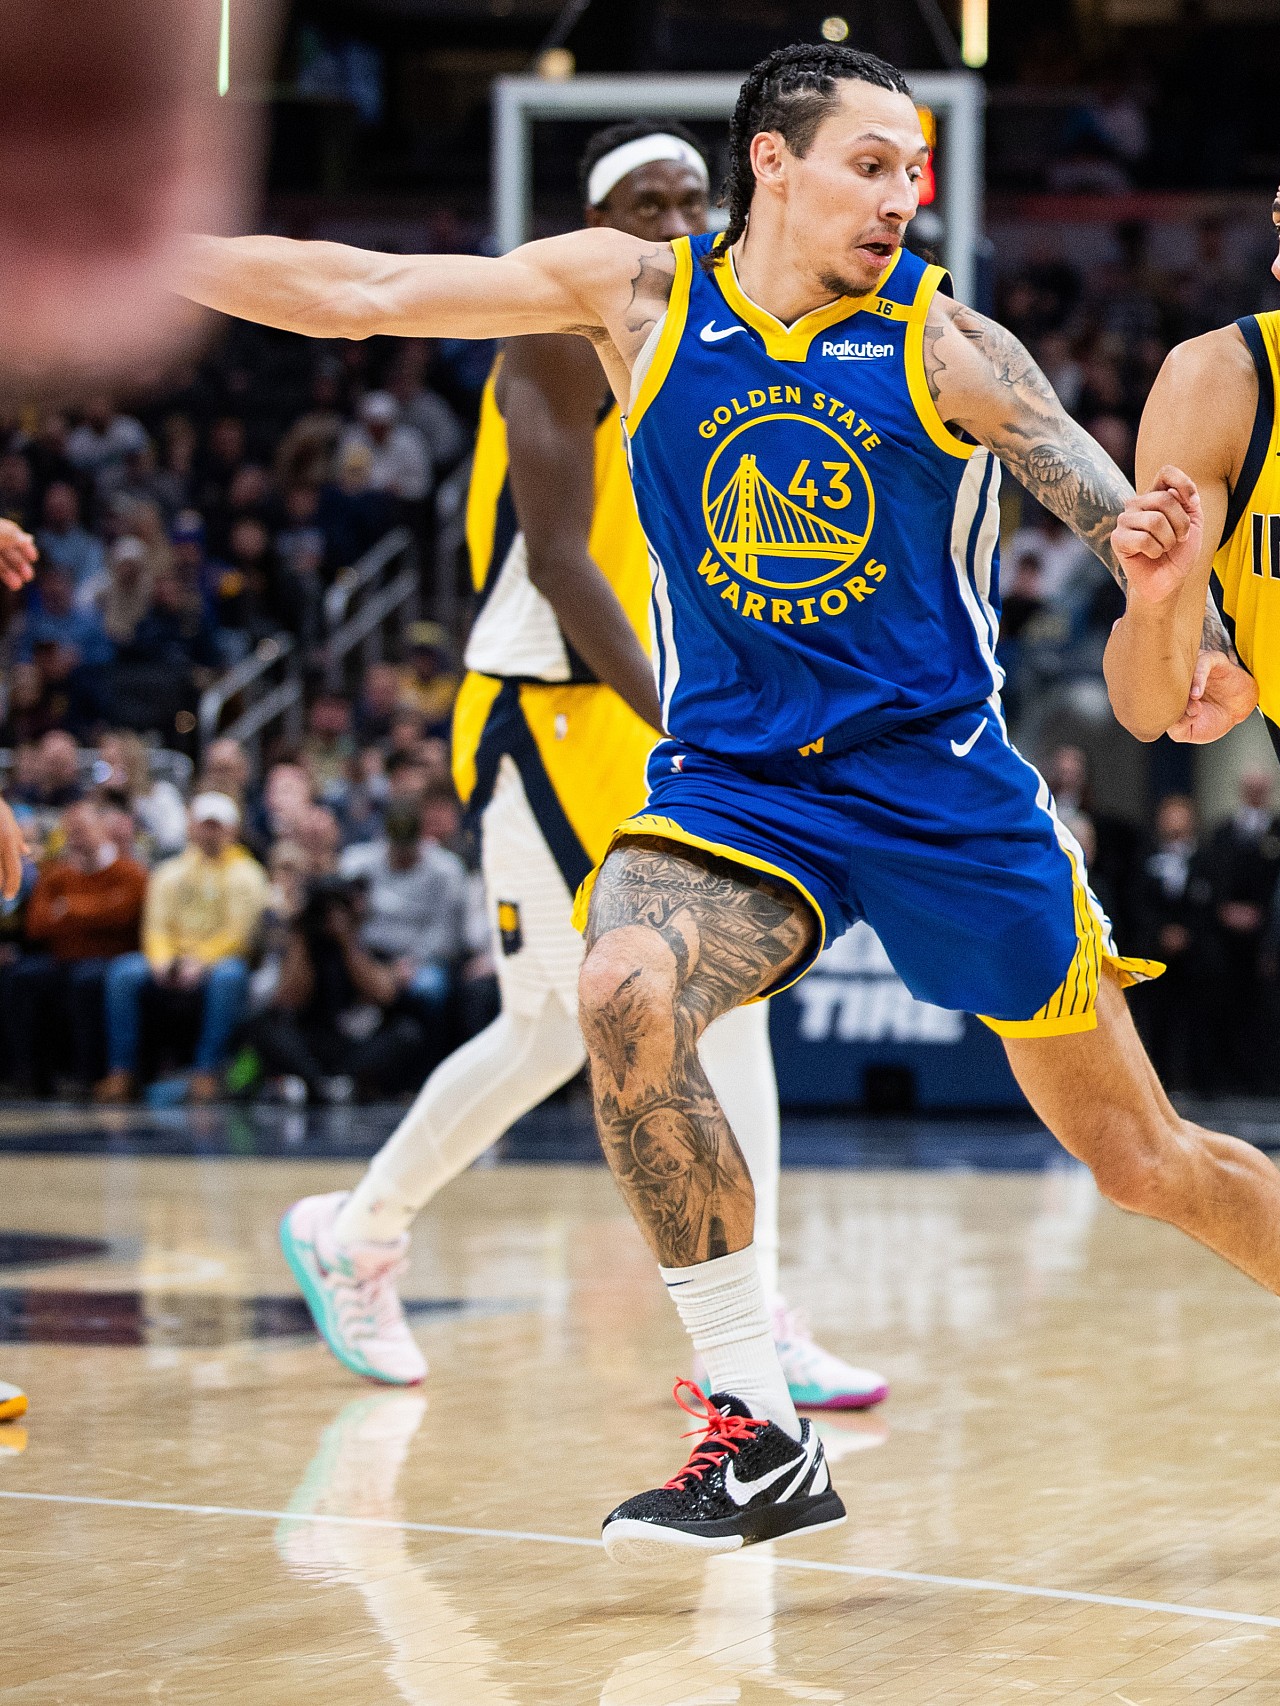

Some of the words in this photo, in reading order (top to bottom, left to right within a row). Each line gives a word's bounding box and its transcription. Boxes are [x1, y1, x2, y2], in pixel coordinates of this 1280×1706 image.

[875, 299, 894, 316] 16
[822, 340, 894, 358] Rakuten
[698, 385, 801, 439] GOLDEN
[812, 392, 882, 452] STATE
[788, 459, 852, 510] 43
[697, 547, 887, 625] WARRIORS
